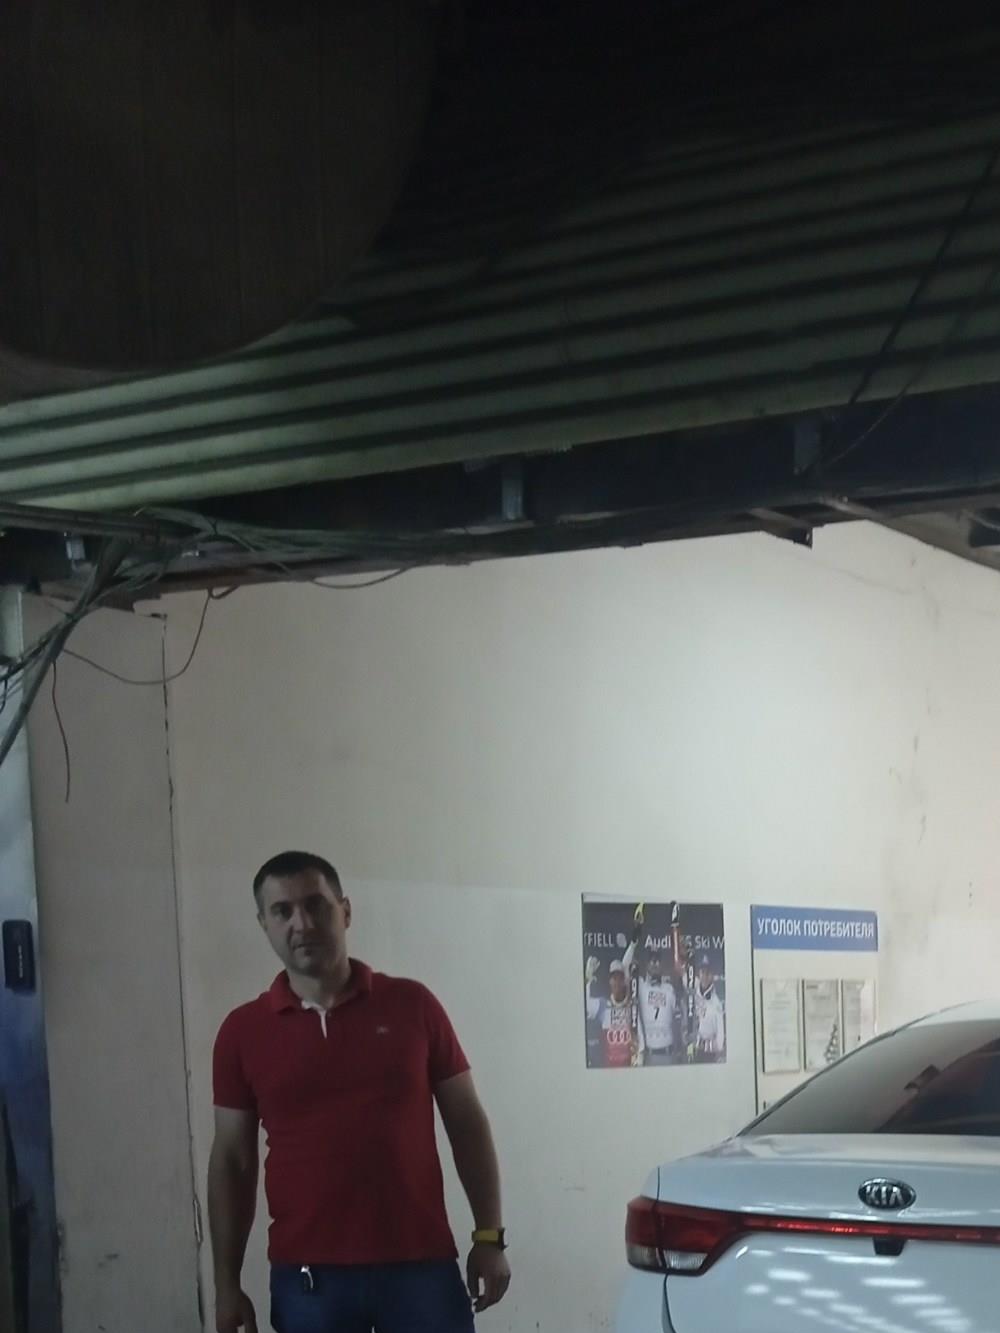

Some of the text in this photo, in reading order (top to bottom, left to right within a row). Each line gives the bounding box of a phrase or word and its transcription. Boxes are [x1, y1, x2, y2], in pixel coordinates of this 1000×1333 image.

[757, 917, 875, 938] УГОЛОК ПОТРЕБИТЕЛЯ
[644, 934, 671, 949] Audi
[694, 935, 710, 949] Ski
[865, 1184, 904, 1206] KIA
